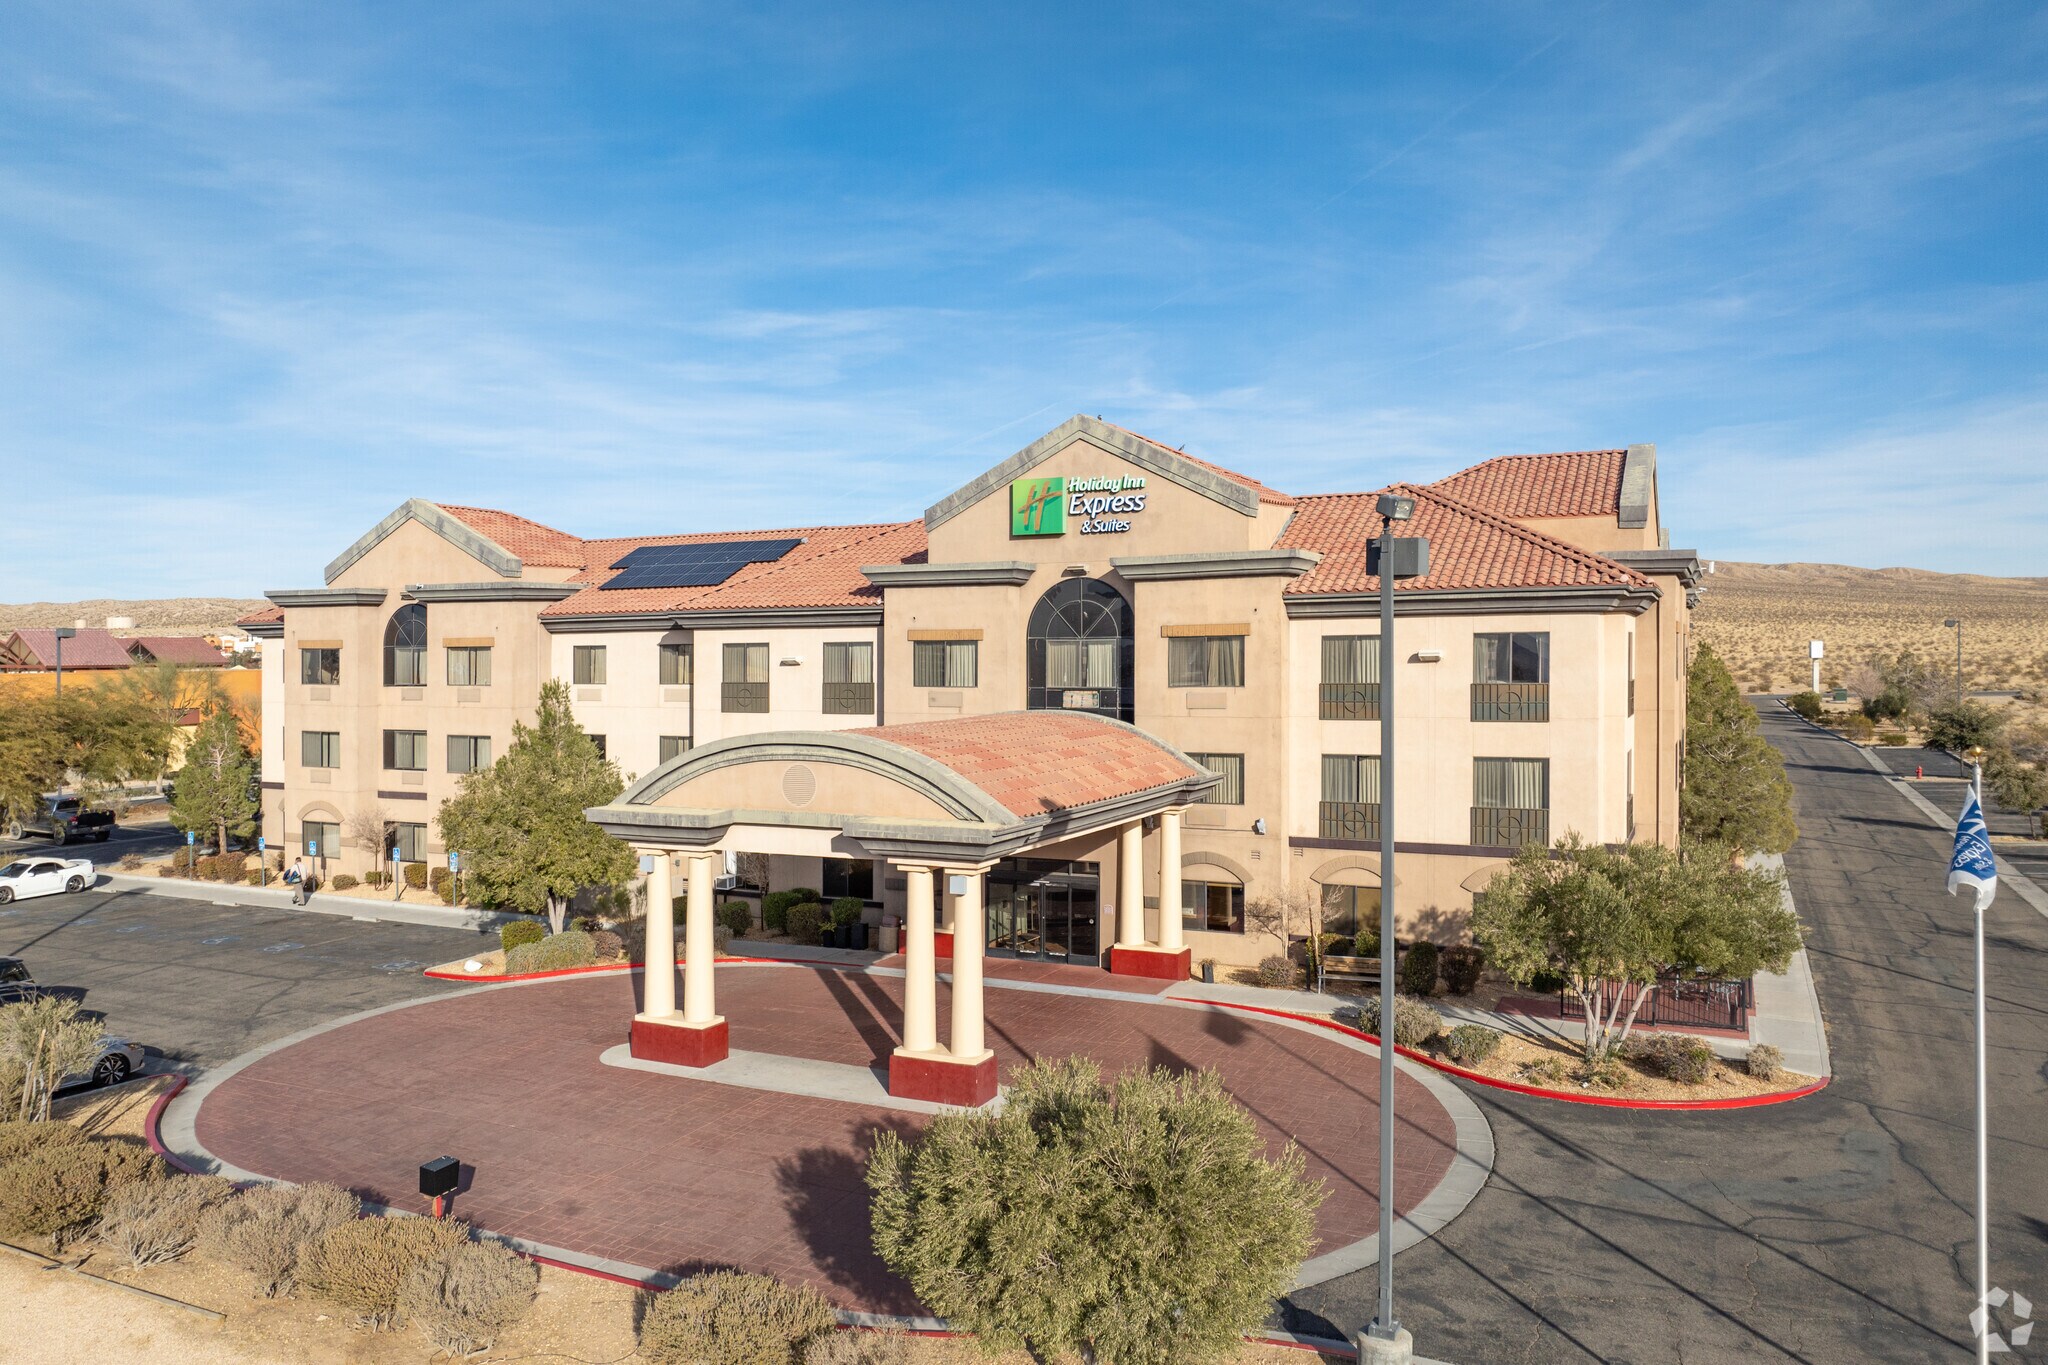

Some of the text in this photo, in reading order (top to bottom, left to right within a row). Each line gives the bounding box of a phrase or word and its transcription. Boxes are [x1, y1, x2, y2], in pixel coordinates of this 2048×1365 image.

[1069, 473, 1146, 493] Holiday Inn
[1069, 494, 1146, 518] Express
[1082, 519, 1130, 533] & Suites
